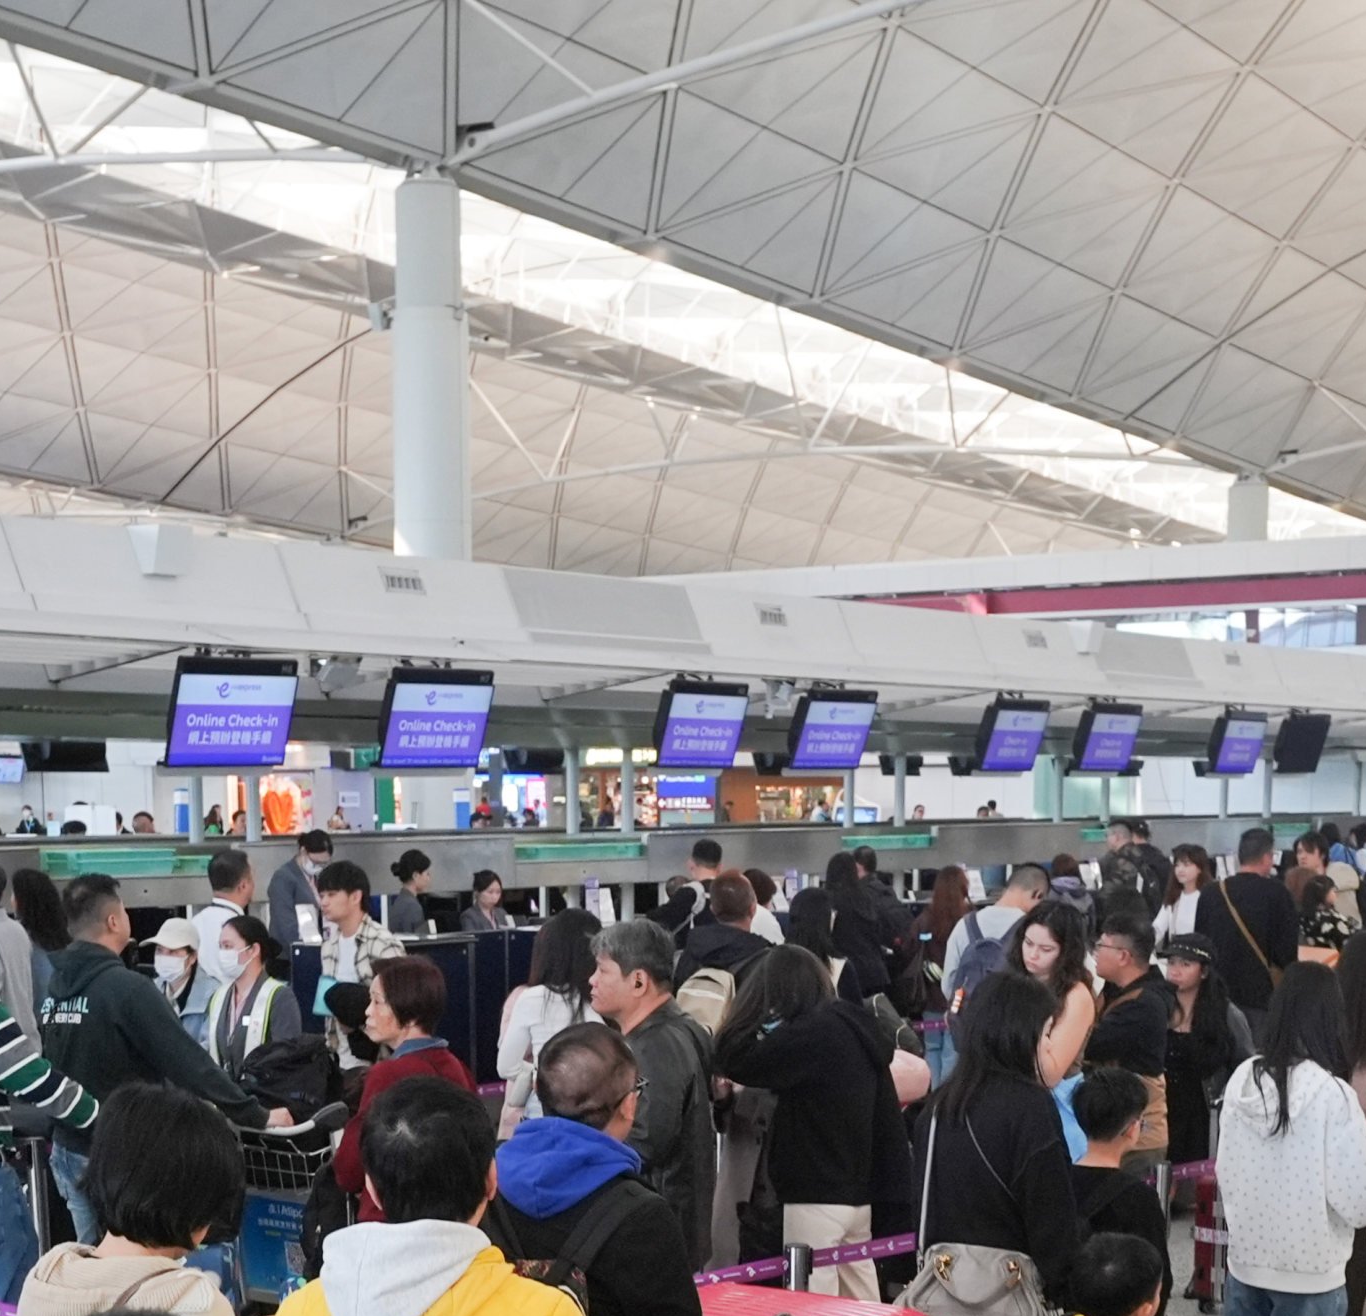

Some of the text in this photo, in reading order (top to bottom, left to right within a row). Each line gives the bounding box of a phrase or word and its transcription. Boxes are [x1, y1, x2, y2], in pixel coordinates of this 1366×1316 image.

[186, 713, 279, 727] Online Check-in
[398, 720, 476, 733] Online Check-in
